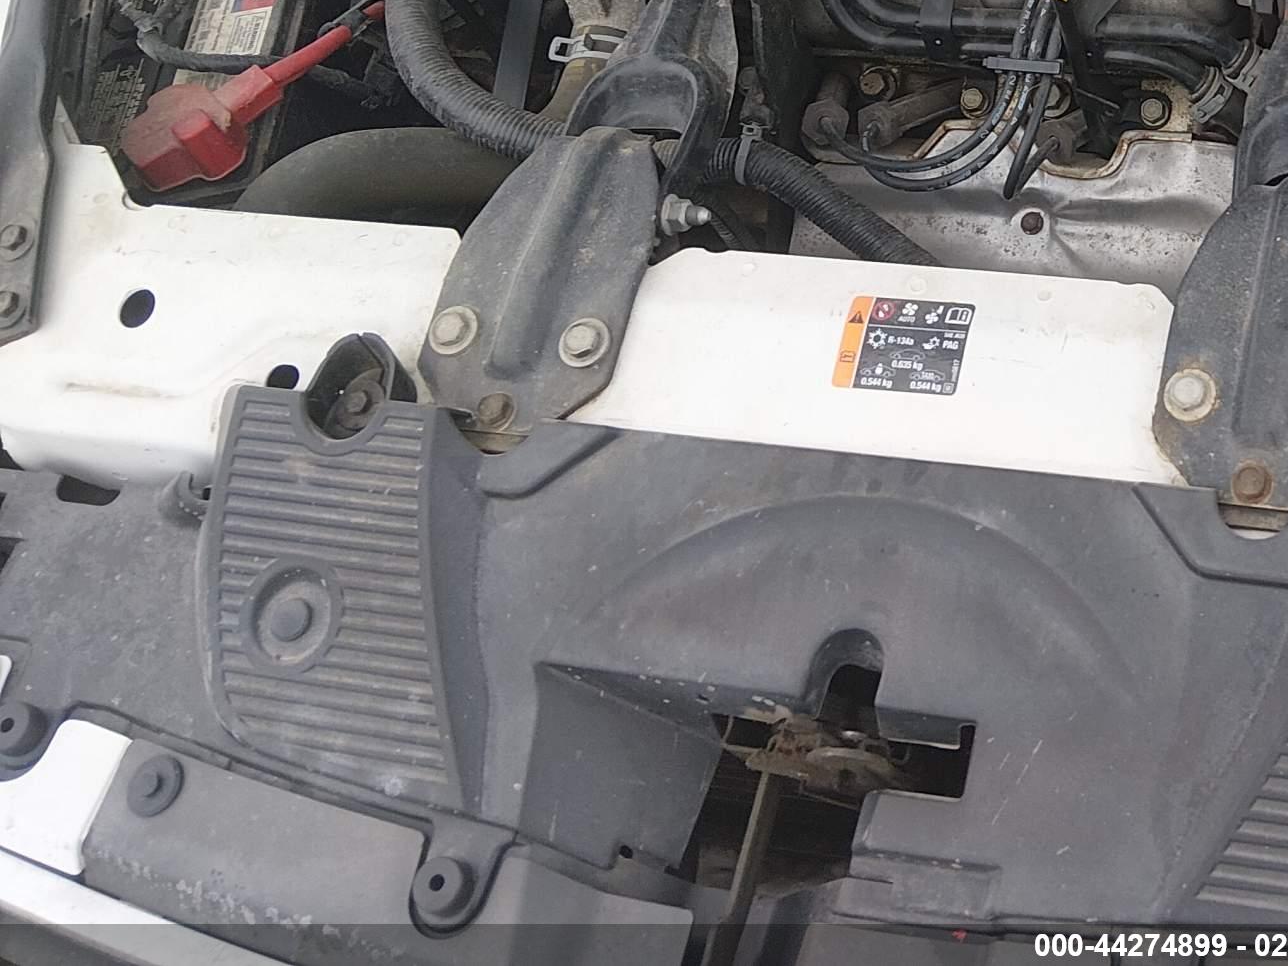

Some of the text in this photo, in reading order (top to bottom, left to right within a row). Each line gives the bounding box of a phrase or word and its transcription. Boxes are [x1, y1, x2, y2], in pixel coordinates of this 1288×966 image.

[942, 340, 959, 350] PAG
[913, 362, 924, 371] kg
[882, 379, 893, 389] kg
[931, 383, 942, 393] kg
